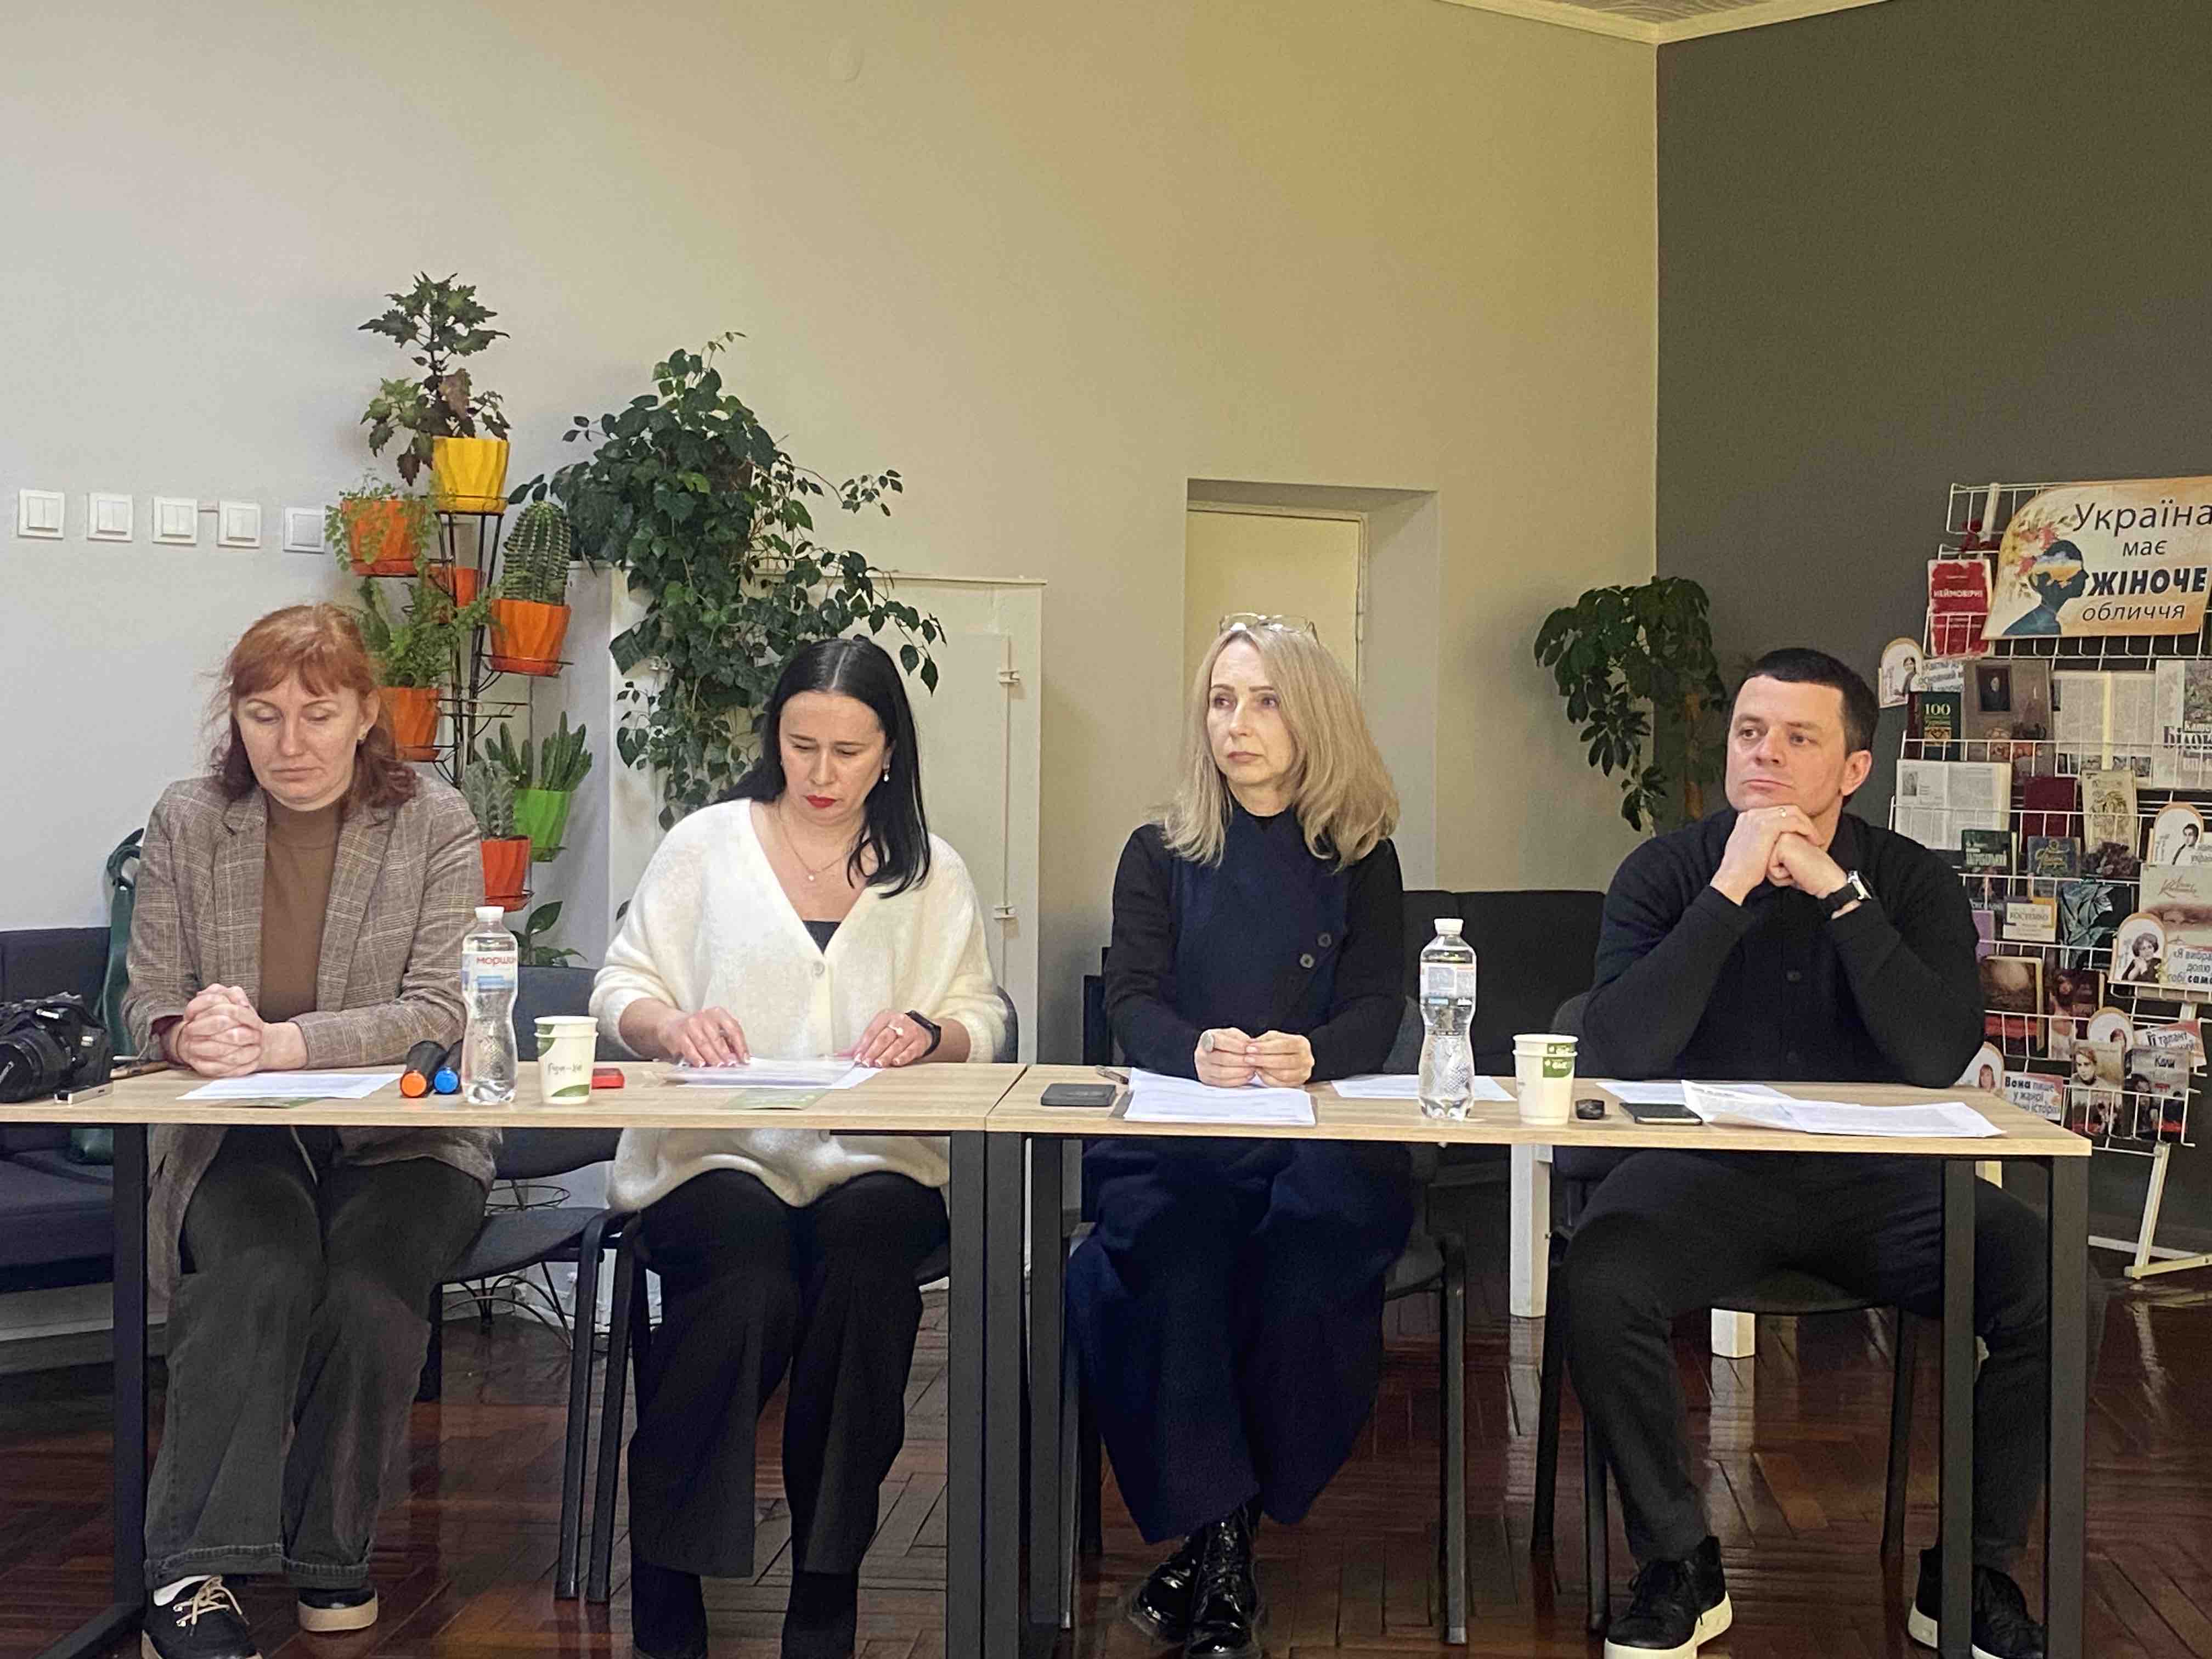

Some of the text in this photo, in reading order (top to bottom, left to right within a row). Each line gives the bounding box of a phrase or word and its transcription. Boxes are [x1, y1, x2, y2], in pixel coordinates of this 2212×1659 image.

[2073, 499, 2212, 537] Україна
[2123, 540, 2168, 557] має
[2087, 567, 2208, 596] ЖІНОЧЕ
[2083, 602, 2185, 621] обличчя
[1925, 703, 1951, 715] 100
[2005, 1076, 2030, 1088] Вона
